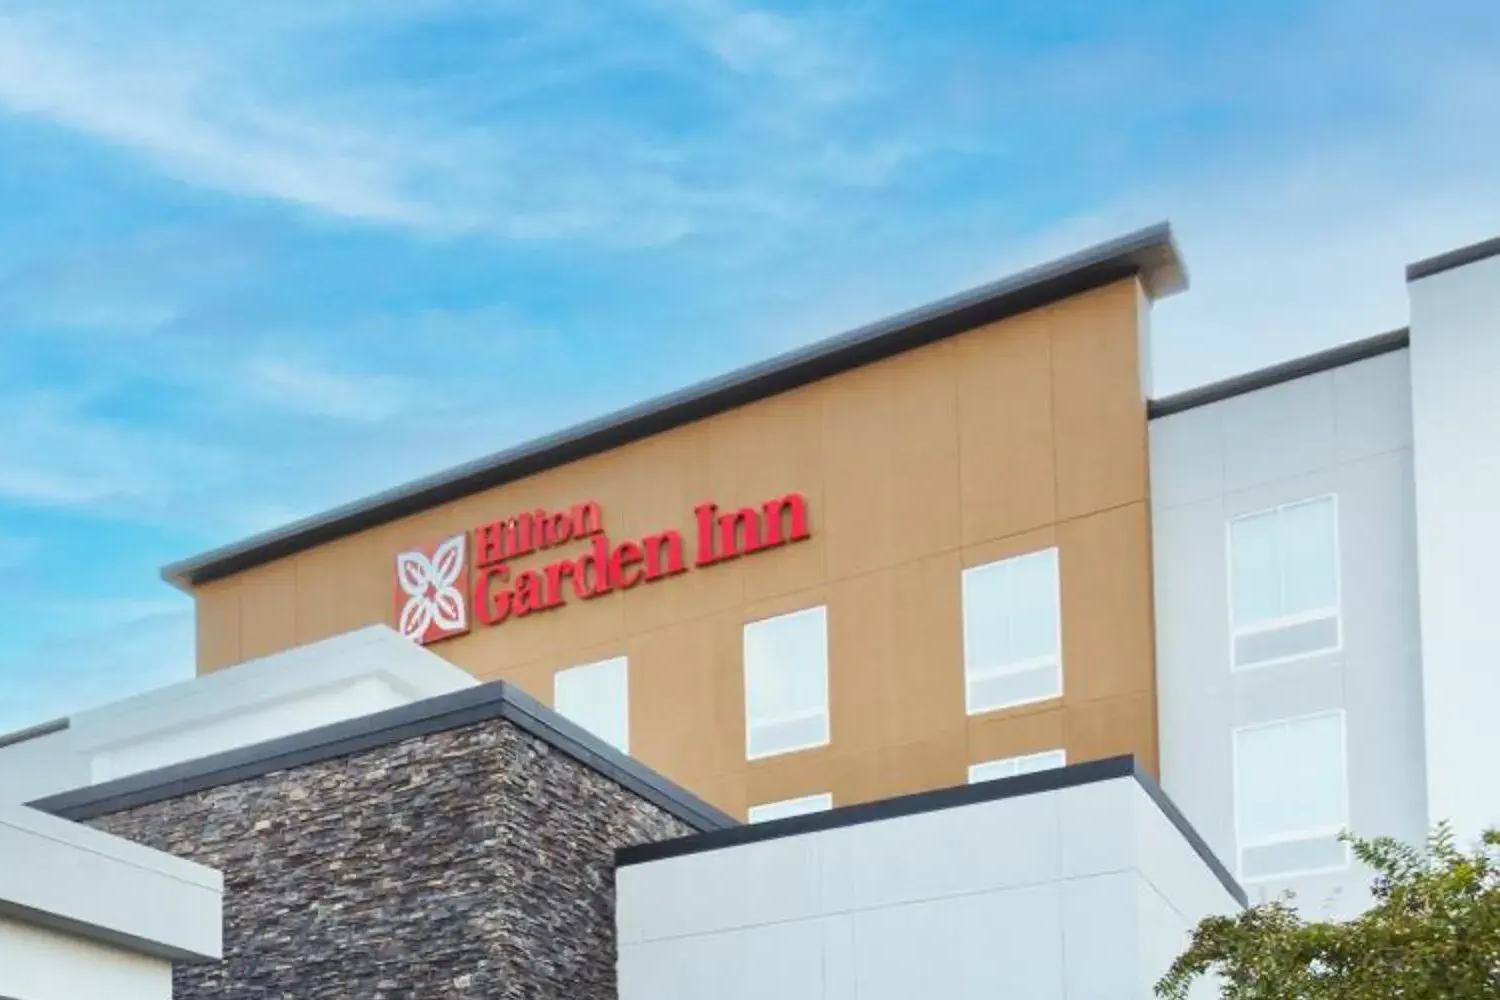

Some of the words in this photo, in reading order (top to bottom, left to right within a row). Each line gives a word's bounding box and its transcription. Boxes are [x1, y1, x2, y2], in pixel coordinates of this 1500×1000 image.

[474, 527, 686, 626] Garden
[695, 492, 810, 567] Inn
[475, 501, 603, 568] Hilton
